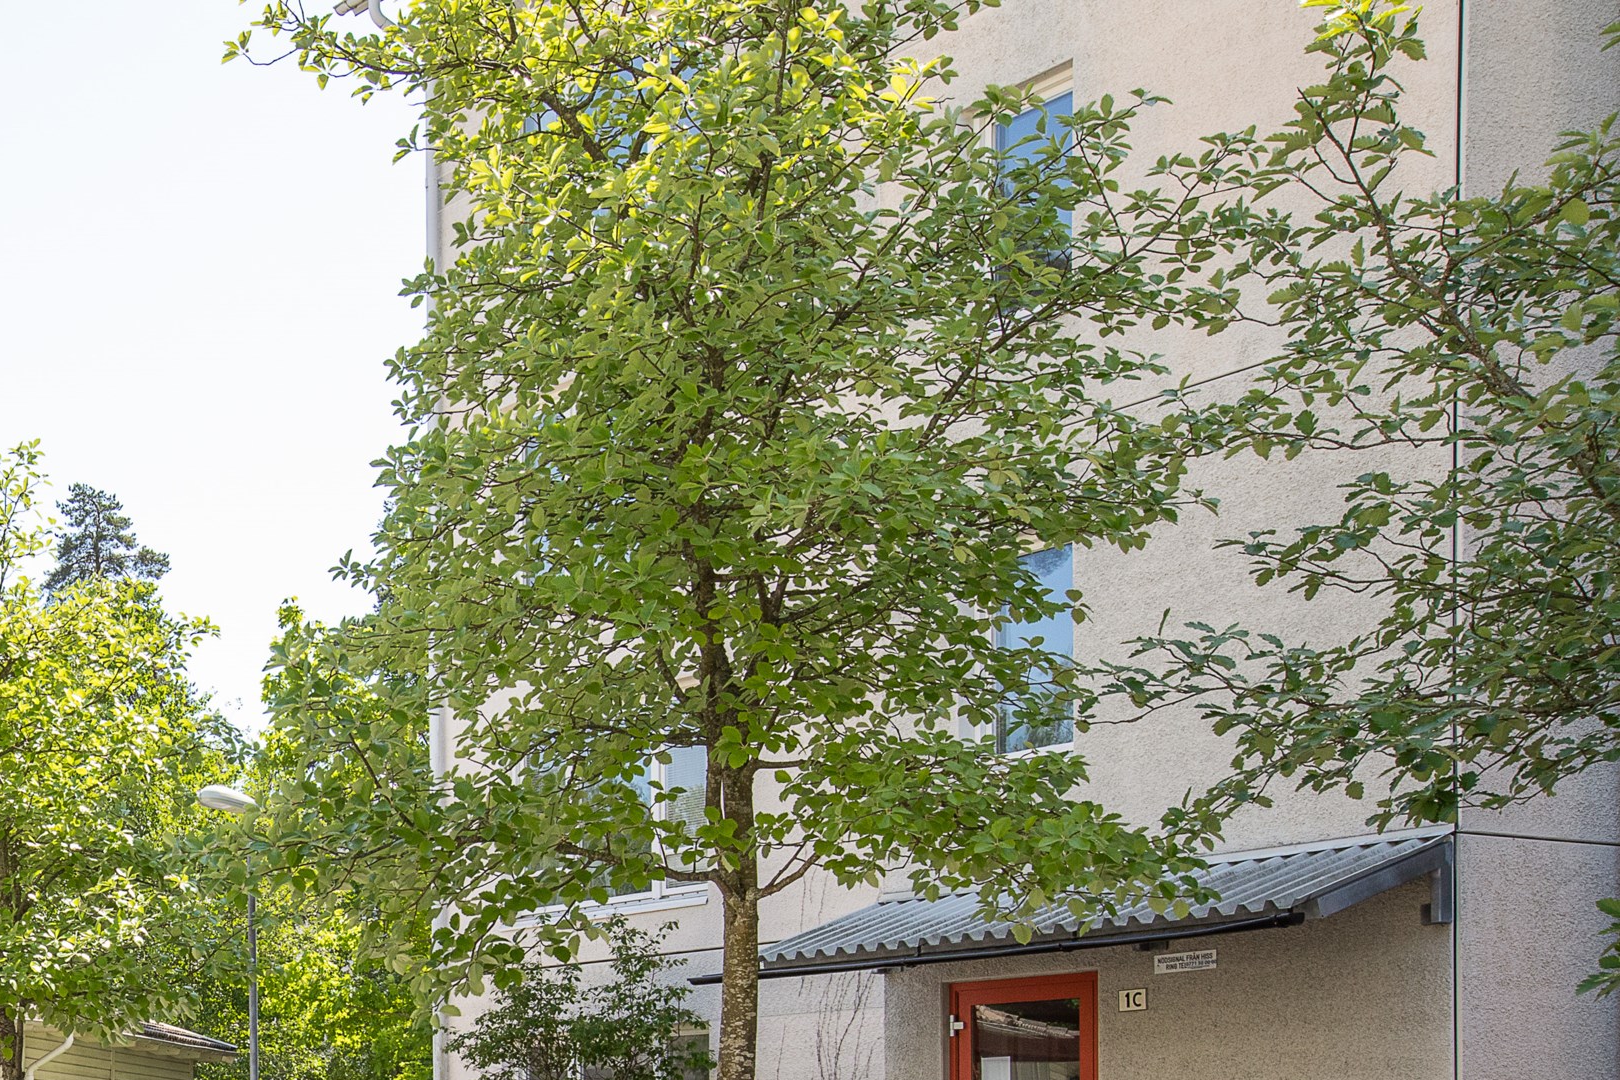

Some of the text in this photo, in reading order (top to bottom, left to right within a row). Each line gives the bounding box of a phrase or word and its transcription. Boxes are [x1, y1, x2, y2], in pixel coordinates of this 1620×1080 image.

[1186, 952, 1200, 961] FRÅN
[1201, 952, 1213, 960] HISS
[1125, 991, 1142, 1008] 1C
